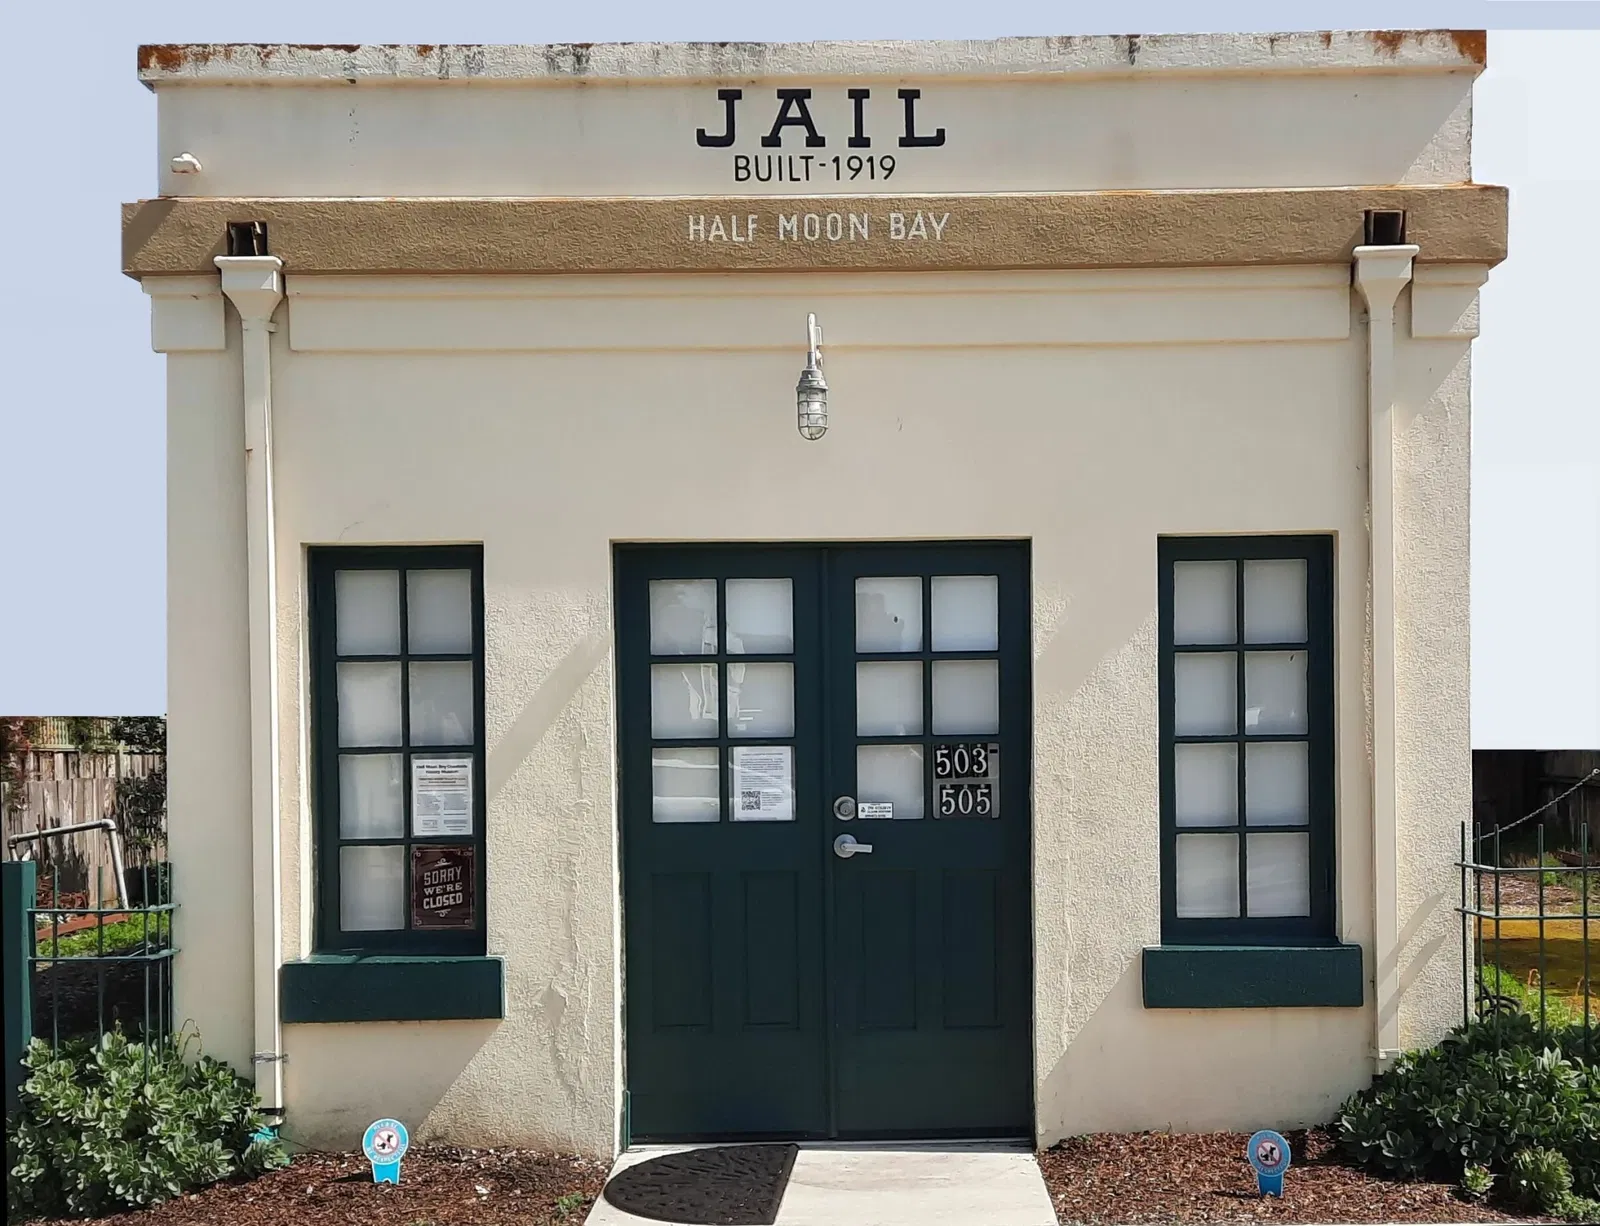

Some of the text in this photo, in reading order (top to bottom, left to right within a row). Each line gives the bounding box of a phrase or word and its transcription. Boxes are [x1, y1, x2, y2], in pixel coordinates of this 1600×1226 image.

[696, 88, 946, 148] JAIL
[734, 155, 896, 182] BUILT-1919
[688, 211, 951, 242] HALF MOON BAY
[941, 788, 991, 815] 505
[423, 866, 463, 886] SORRY
[423, 882, 463, 896] WE'RE
[423, 892, 463, 910] CLOSED
